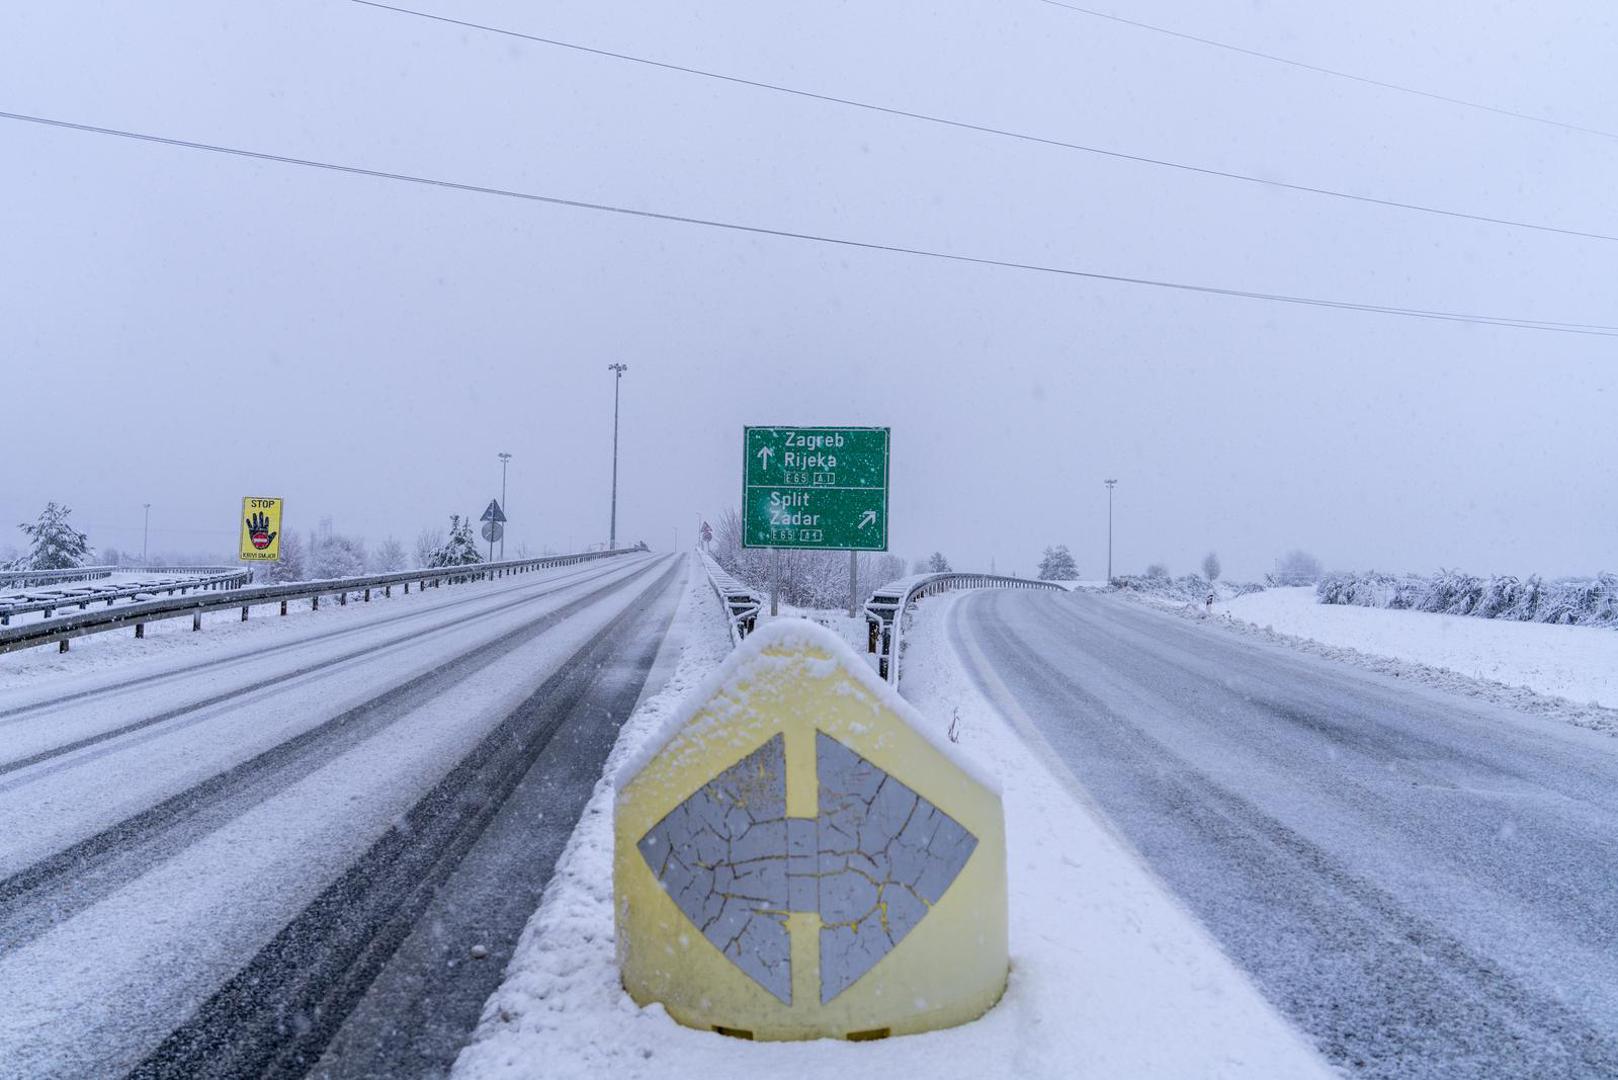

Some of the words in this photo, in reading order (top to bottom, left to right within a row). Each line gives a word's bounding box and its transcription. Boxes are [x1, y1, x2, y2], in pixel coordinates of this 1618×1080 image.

[785, 432, 844, 450] Zagreb
[784, 452, 837, 470] Rijeka
[251, 499, 275, 508] STOP
[770, 491, 810, 509] Split
[770, 510, 820, 526] Zadar
